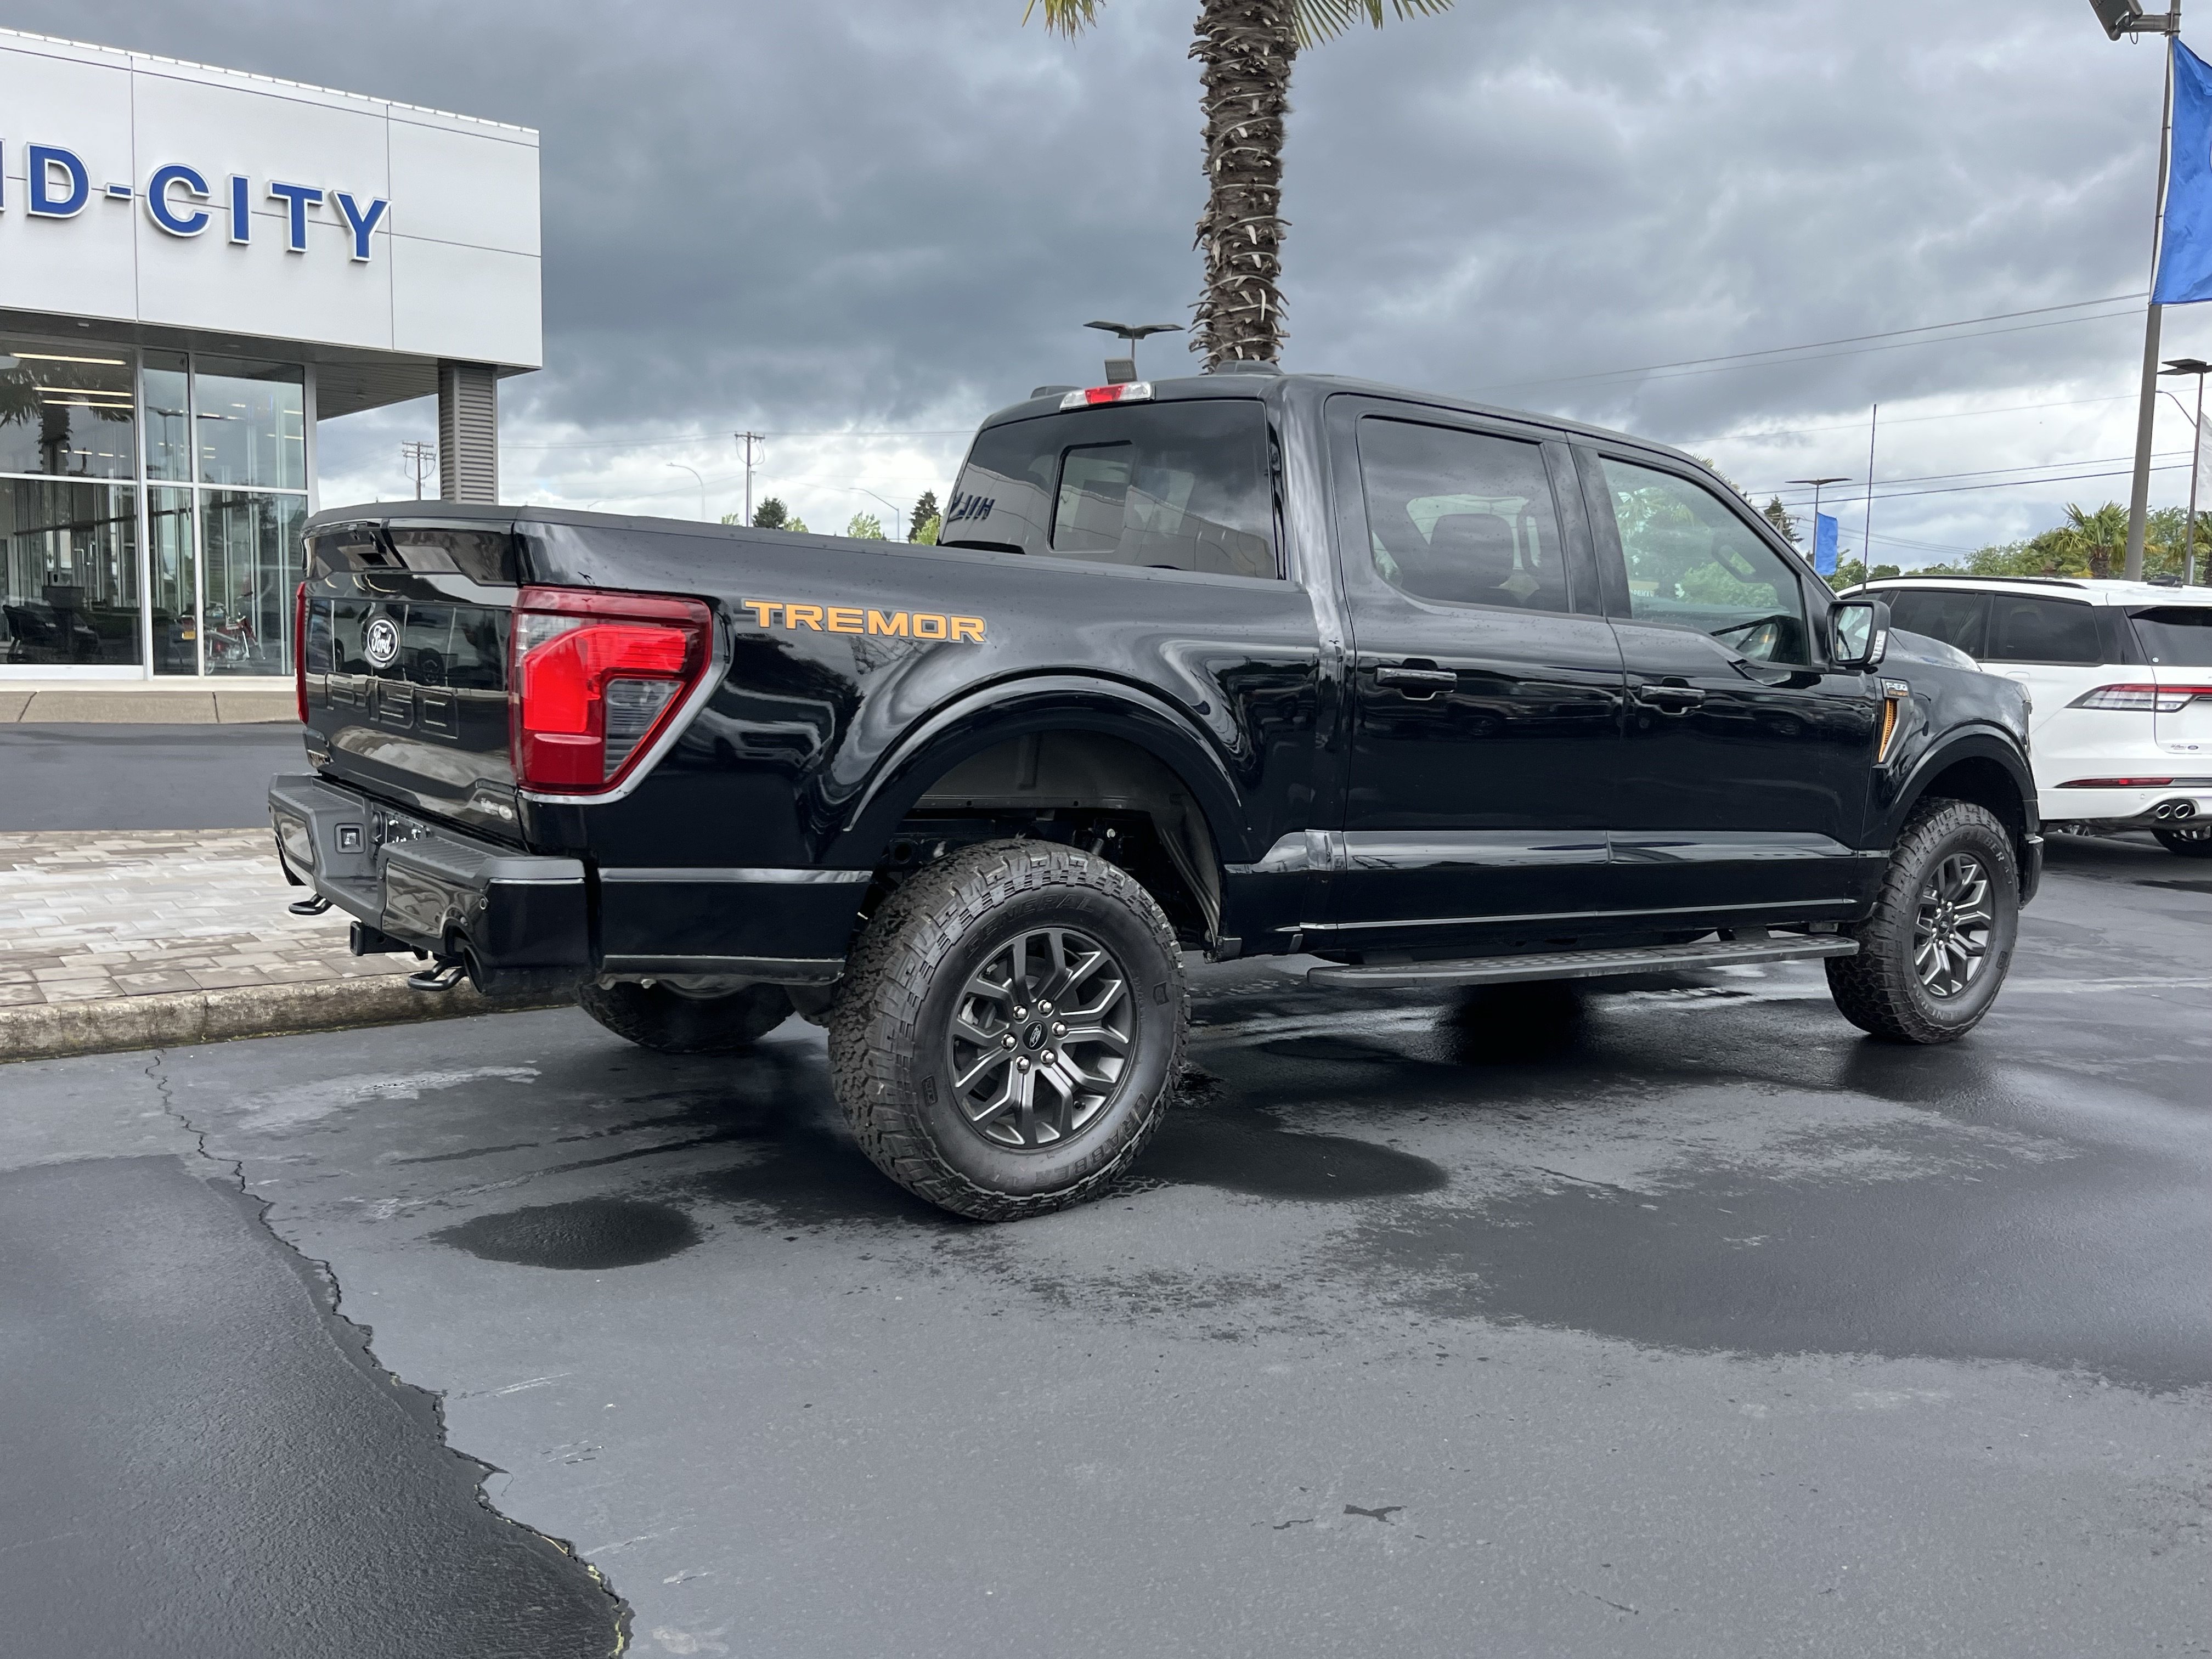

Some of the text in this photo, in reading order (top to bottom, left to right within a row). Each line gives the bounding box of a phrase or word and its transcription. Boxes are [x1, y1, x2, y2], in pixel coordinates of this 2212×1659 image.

[0, 138, 391, 262] D-CITY
[744, 600, 985, 643] TREMOR
[963, 894, 1094, 960] GENERAL
[1035, 1091, 1149, 1187] GRABBER
